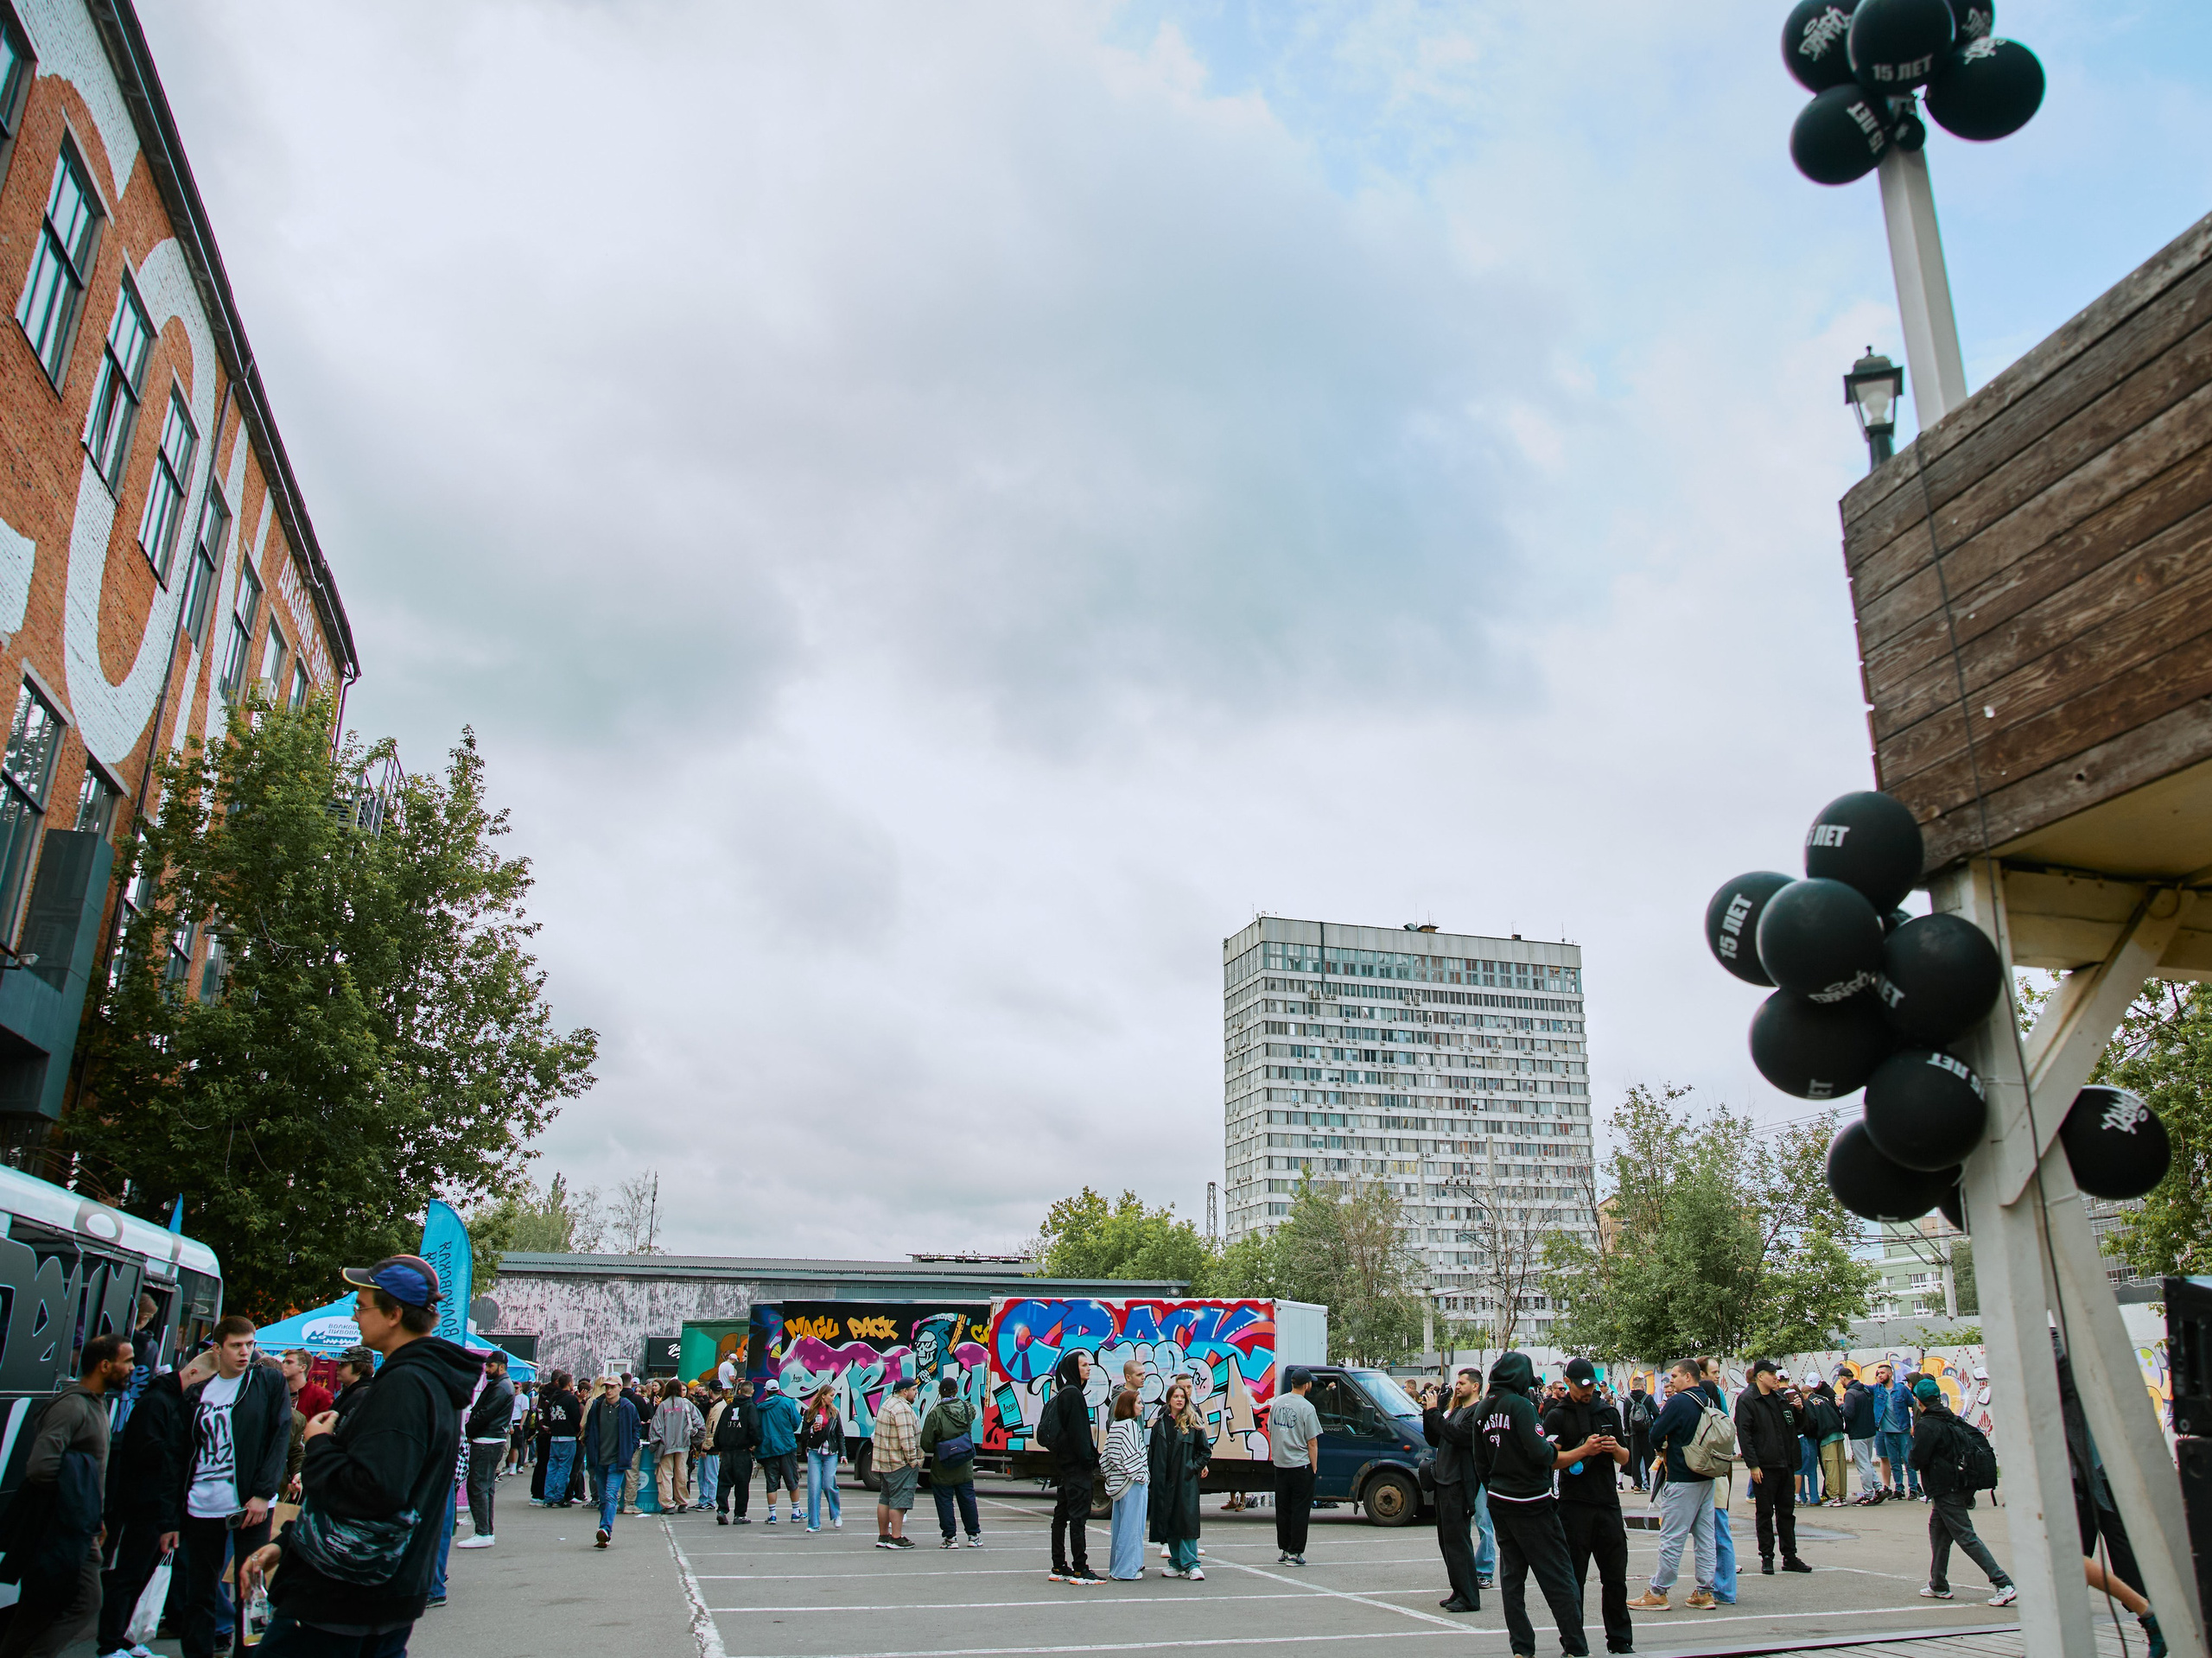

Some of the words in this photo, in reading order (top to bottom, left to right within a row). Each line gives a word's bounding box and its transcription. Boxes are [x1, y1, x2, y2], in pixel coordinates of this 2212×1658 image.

[1872, 63, 1892, 81] 15
[1897, 54, 1933, 81] ЛЕТ
[1846, 100, 1879, 135] ЛЕТ
[1811, 824, 1851, 848] ЛЕТ
[1722, 893, 1753, 937] ЛЕТ
[1719, 934, 1739, 959] 15
[1926, 1052, 1971, 1080] ЛЕТ
[847, 1315, 899, 1341] PACK
[731, 1407, 741, 1420] 1
[1477, 1413, 1510, 1434] USSIA
